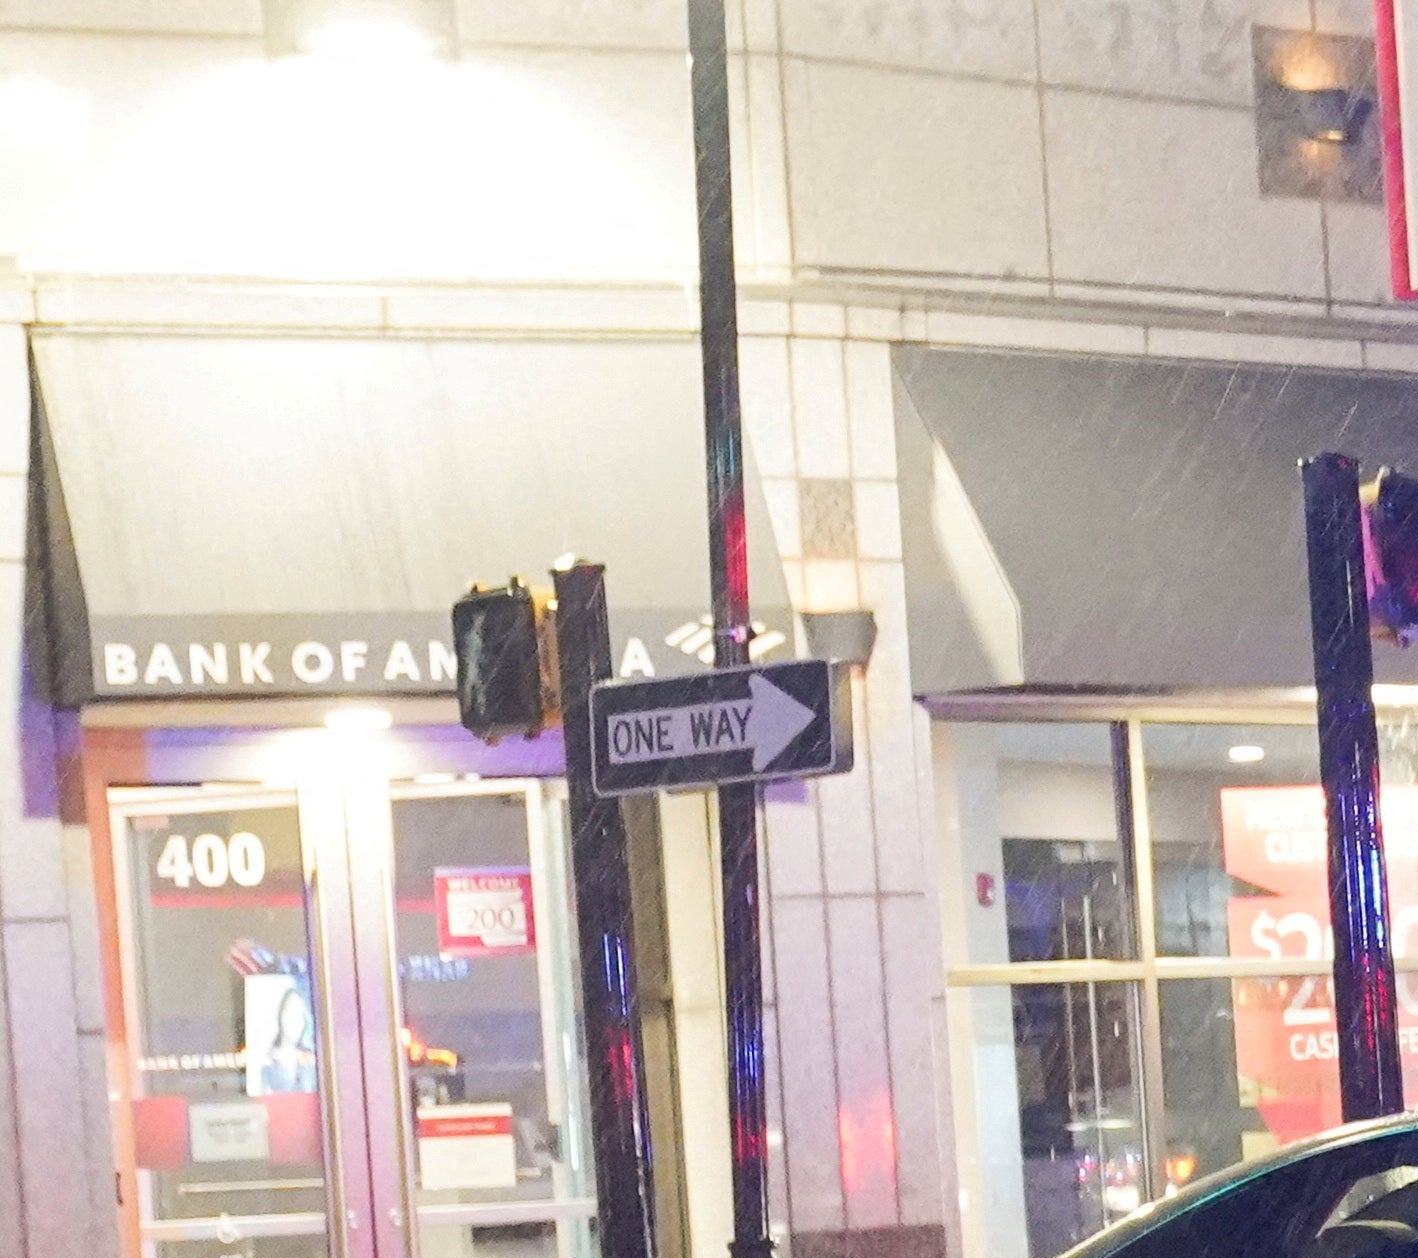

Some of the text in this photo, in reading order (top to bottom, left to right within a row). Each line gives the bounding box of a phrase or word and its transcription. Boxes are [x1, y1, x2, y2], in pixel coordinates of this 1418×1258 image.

[103, 640, 275, 686] BANK
[291, 639, 369, 684] OF
[613, 705, 753, 757] ONE WAY
[156, 831, 266, 888] 400
[1289, 1032, 1339, 1060] CAS
